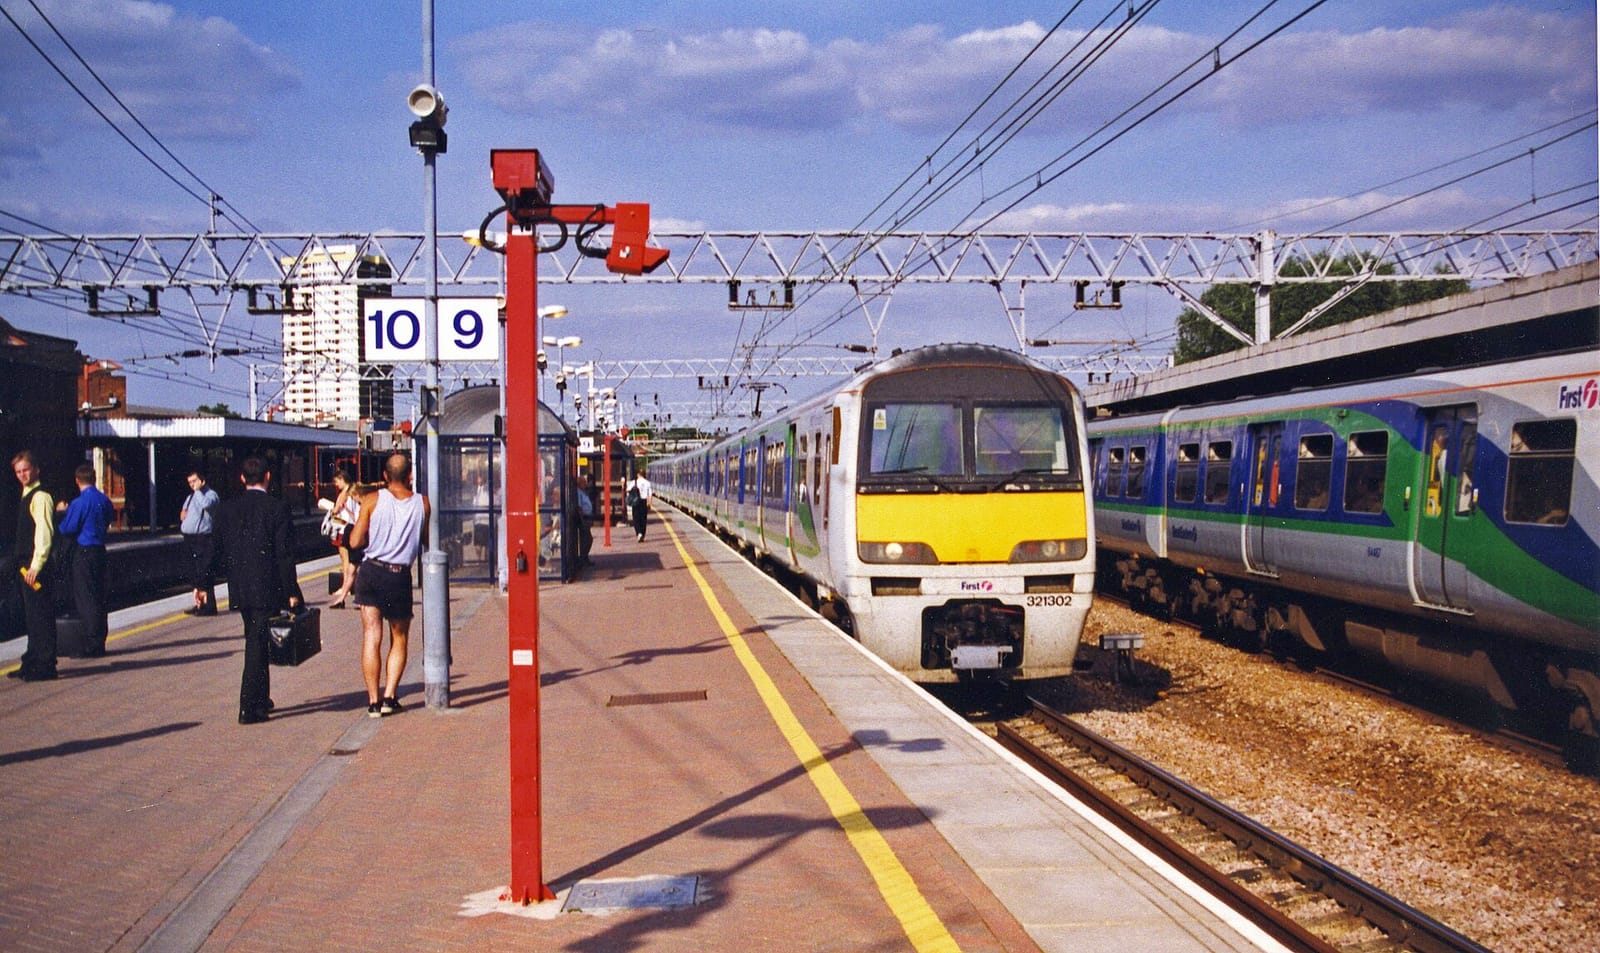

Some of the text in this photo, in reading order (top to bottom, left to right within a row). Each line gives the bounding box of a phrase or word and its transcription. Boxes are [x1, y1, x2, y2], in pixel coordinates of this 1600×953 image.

[368, 309, 421, 350] 10
[453, 309, 483, 350] 9
[1559, 385, 1582, 409] First
[961, 581, 980, 590] First
[1026, 596, 1072, 607] 321302
